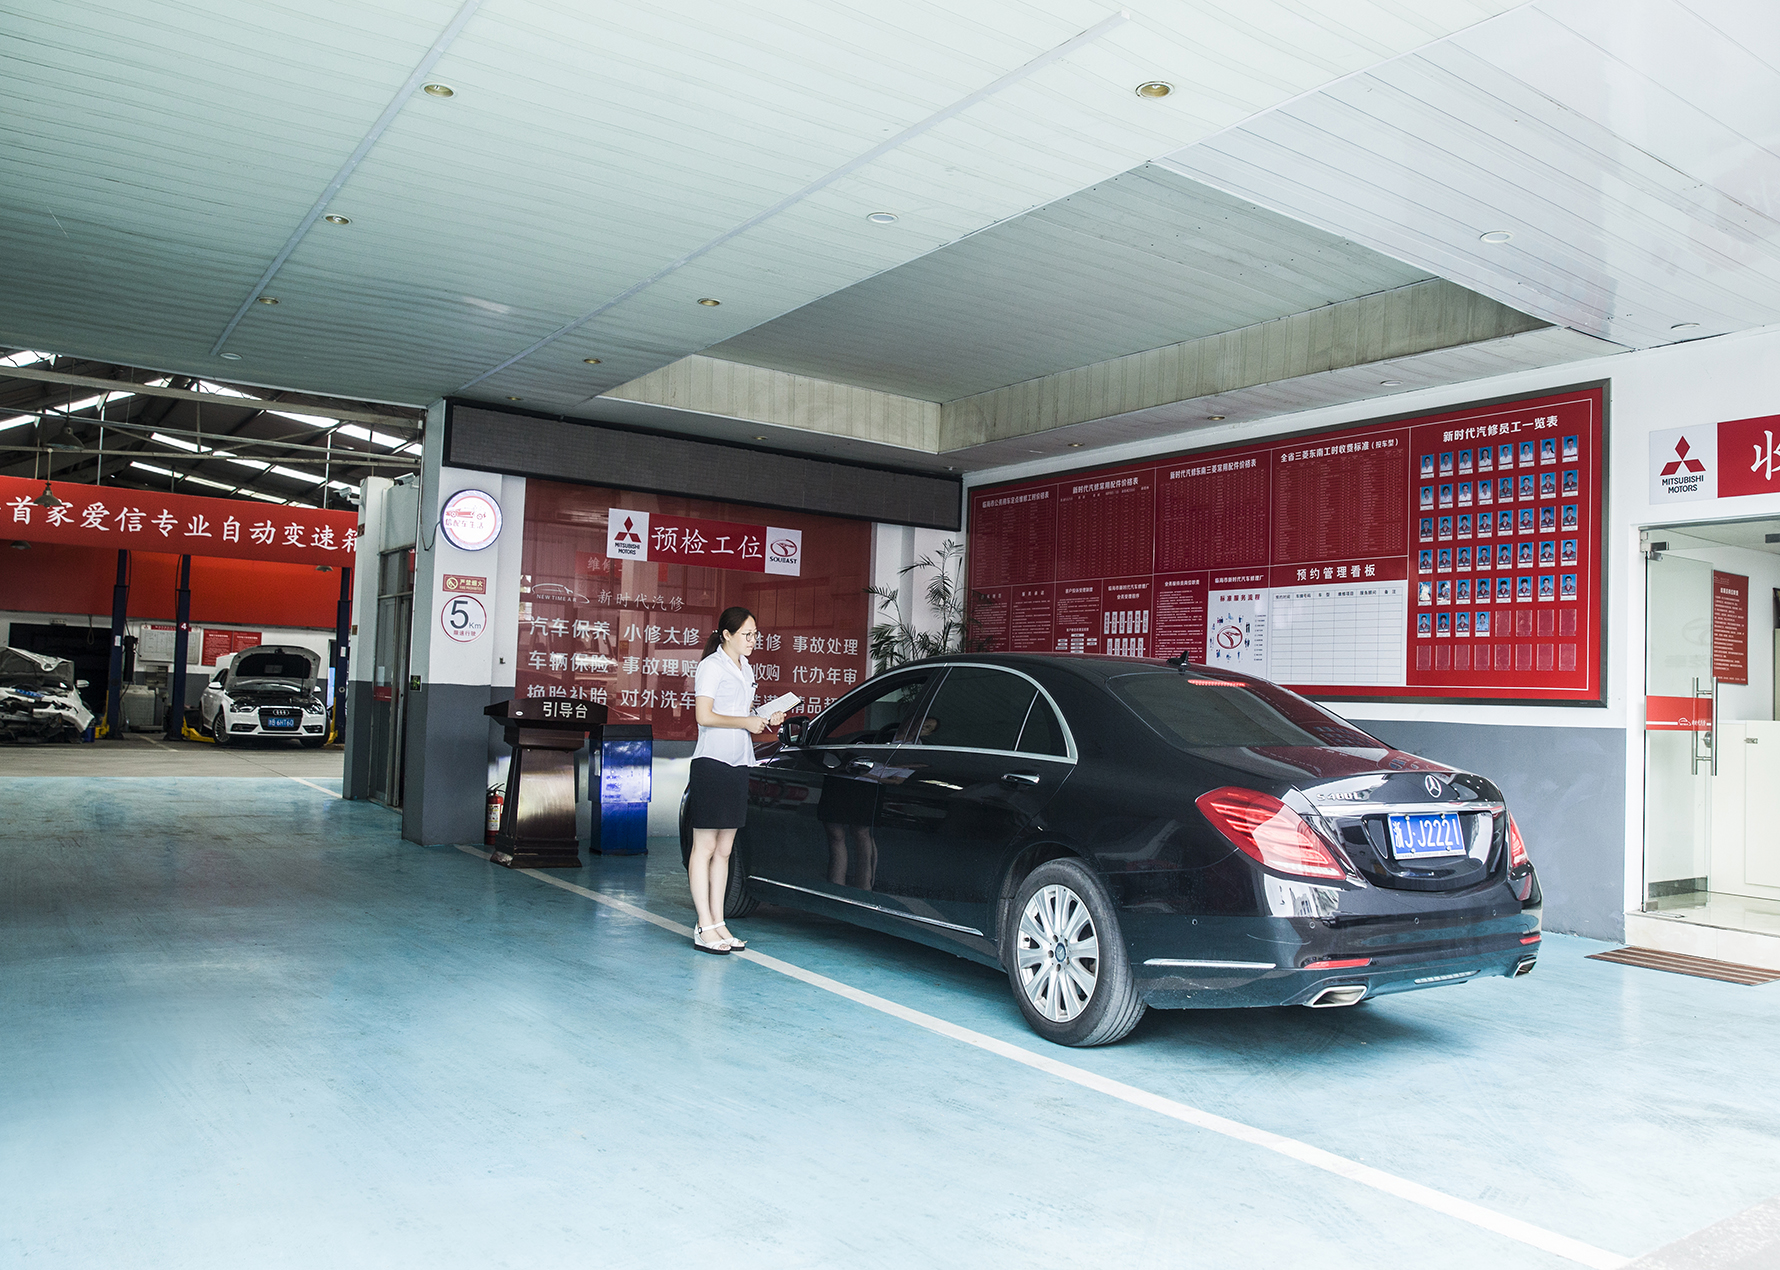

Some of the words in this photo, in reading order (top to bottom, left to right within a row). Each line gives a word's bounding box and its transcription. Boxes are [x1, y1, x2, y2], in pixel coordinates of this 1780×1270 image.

[1443, 415, 1559, 442] 新时代汽修员工一览表
[1661, 475, 1704, 486] MITSUBISHI
[1667, 484, 1698, 494] MOTORS
[651, 526, 763, 559] 预检工位
[1296, 564, 1376, 581] 预约管理看板
[598, 588, 685, 613] 新时代汽修
[180, 622, 188, 630] 4
[449, 600, 469, 629] 5
[468, 622, 482, 630] Km
[529, 616, 611, 640] 汽车保养
[623, 623, 700, 646] 小修大修
[792, 635, 858, 655] 事故处理
[527, 650, 609, 673] 车辆保险
[622, 655, 698, 678] 事故理赔
[792, 665, 858, 685] 代办年审
[543, 701, 588, 719] 引导台
[620, 688, 696, 709] 对外洗车
